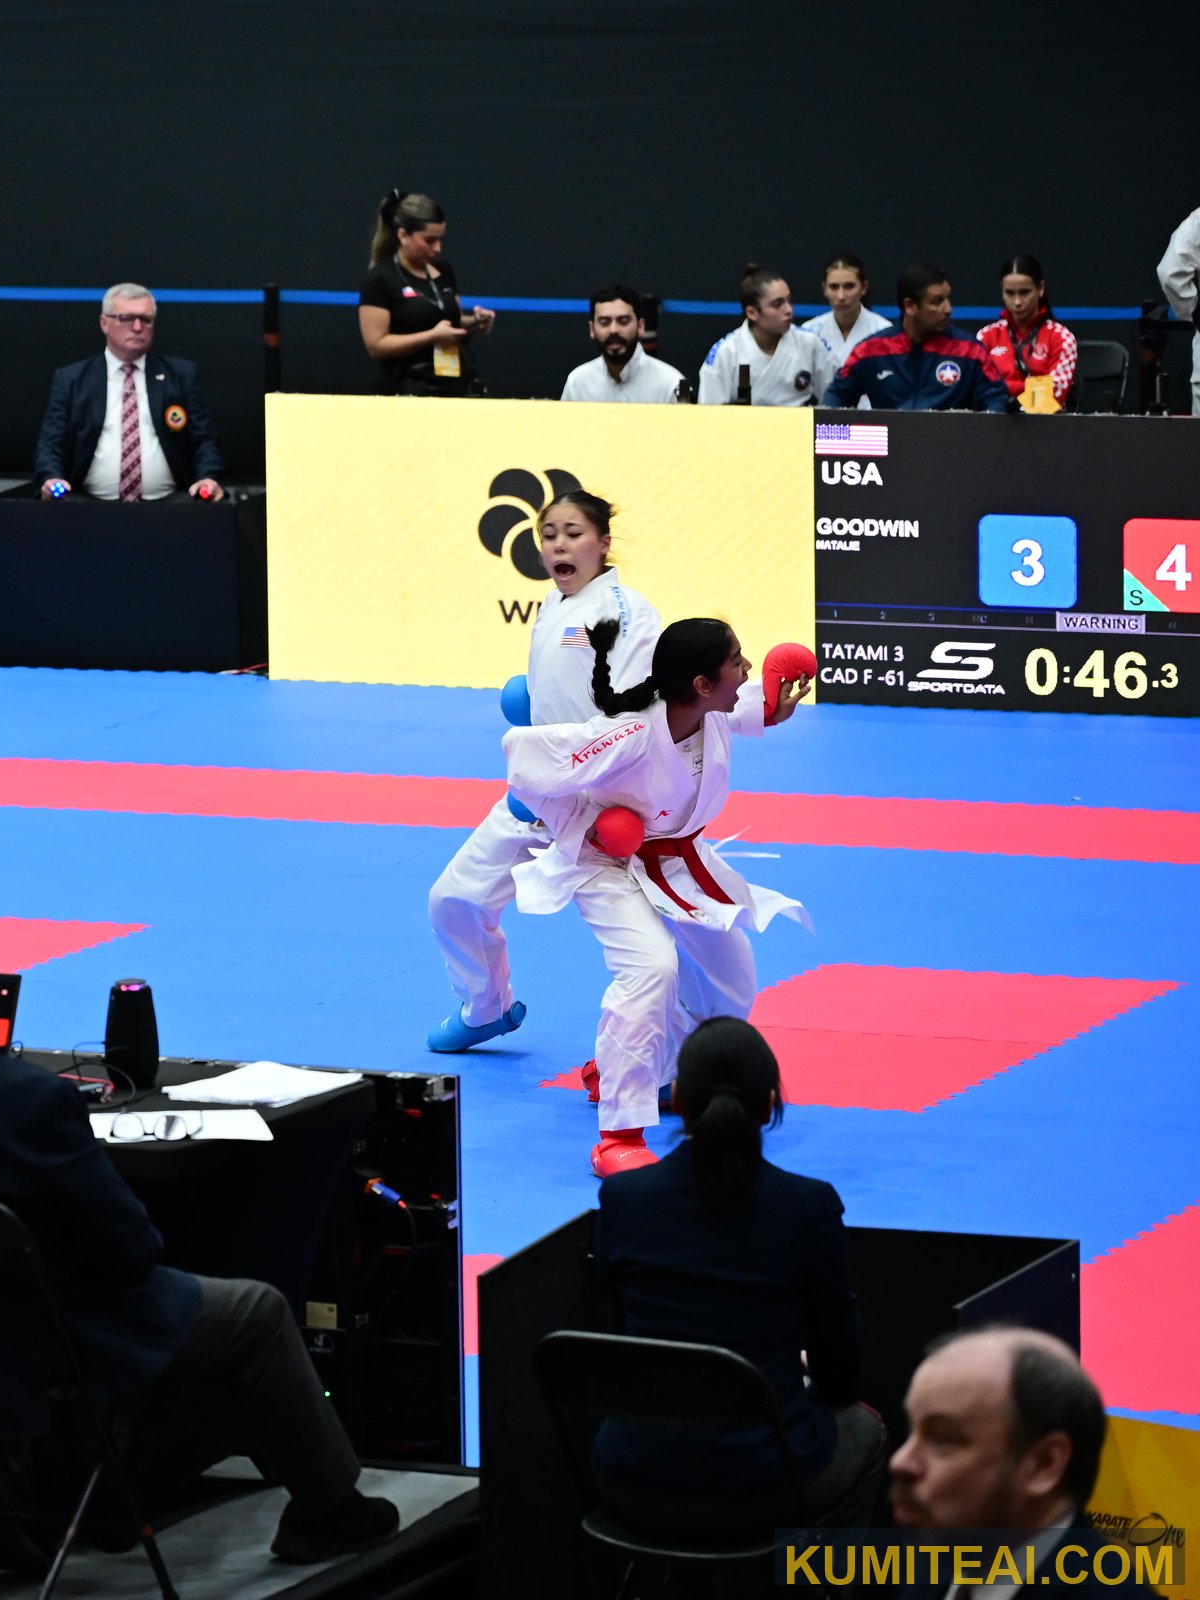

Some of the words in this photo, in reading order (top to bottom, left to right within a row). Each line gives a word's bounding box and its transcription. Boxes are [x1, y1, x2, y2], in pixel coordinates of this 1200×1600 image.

[821, 460, 883, 486] USA
[816, 517, 919, 538] GOODWIN
[1011, 538, 1045, 587] 3
[1155, 543, 1192, 591] 4
[1129, 589, 1144, 606] S
[1064, 616, 1139, 631] WARNING
[822, 642, 888, 662] TATAMI
[893, 645, 905, 662] 3
[820, 667, 858, 684] CAD
[863, 668, 873, 685] F
[877, 669, 905, 687] -61
[1025, 647, 1179, 699] 0:46.3
[907, 681, 1006, 695] SPORTDATA
[571, 721, 646, 769] Arawaza
